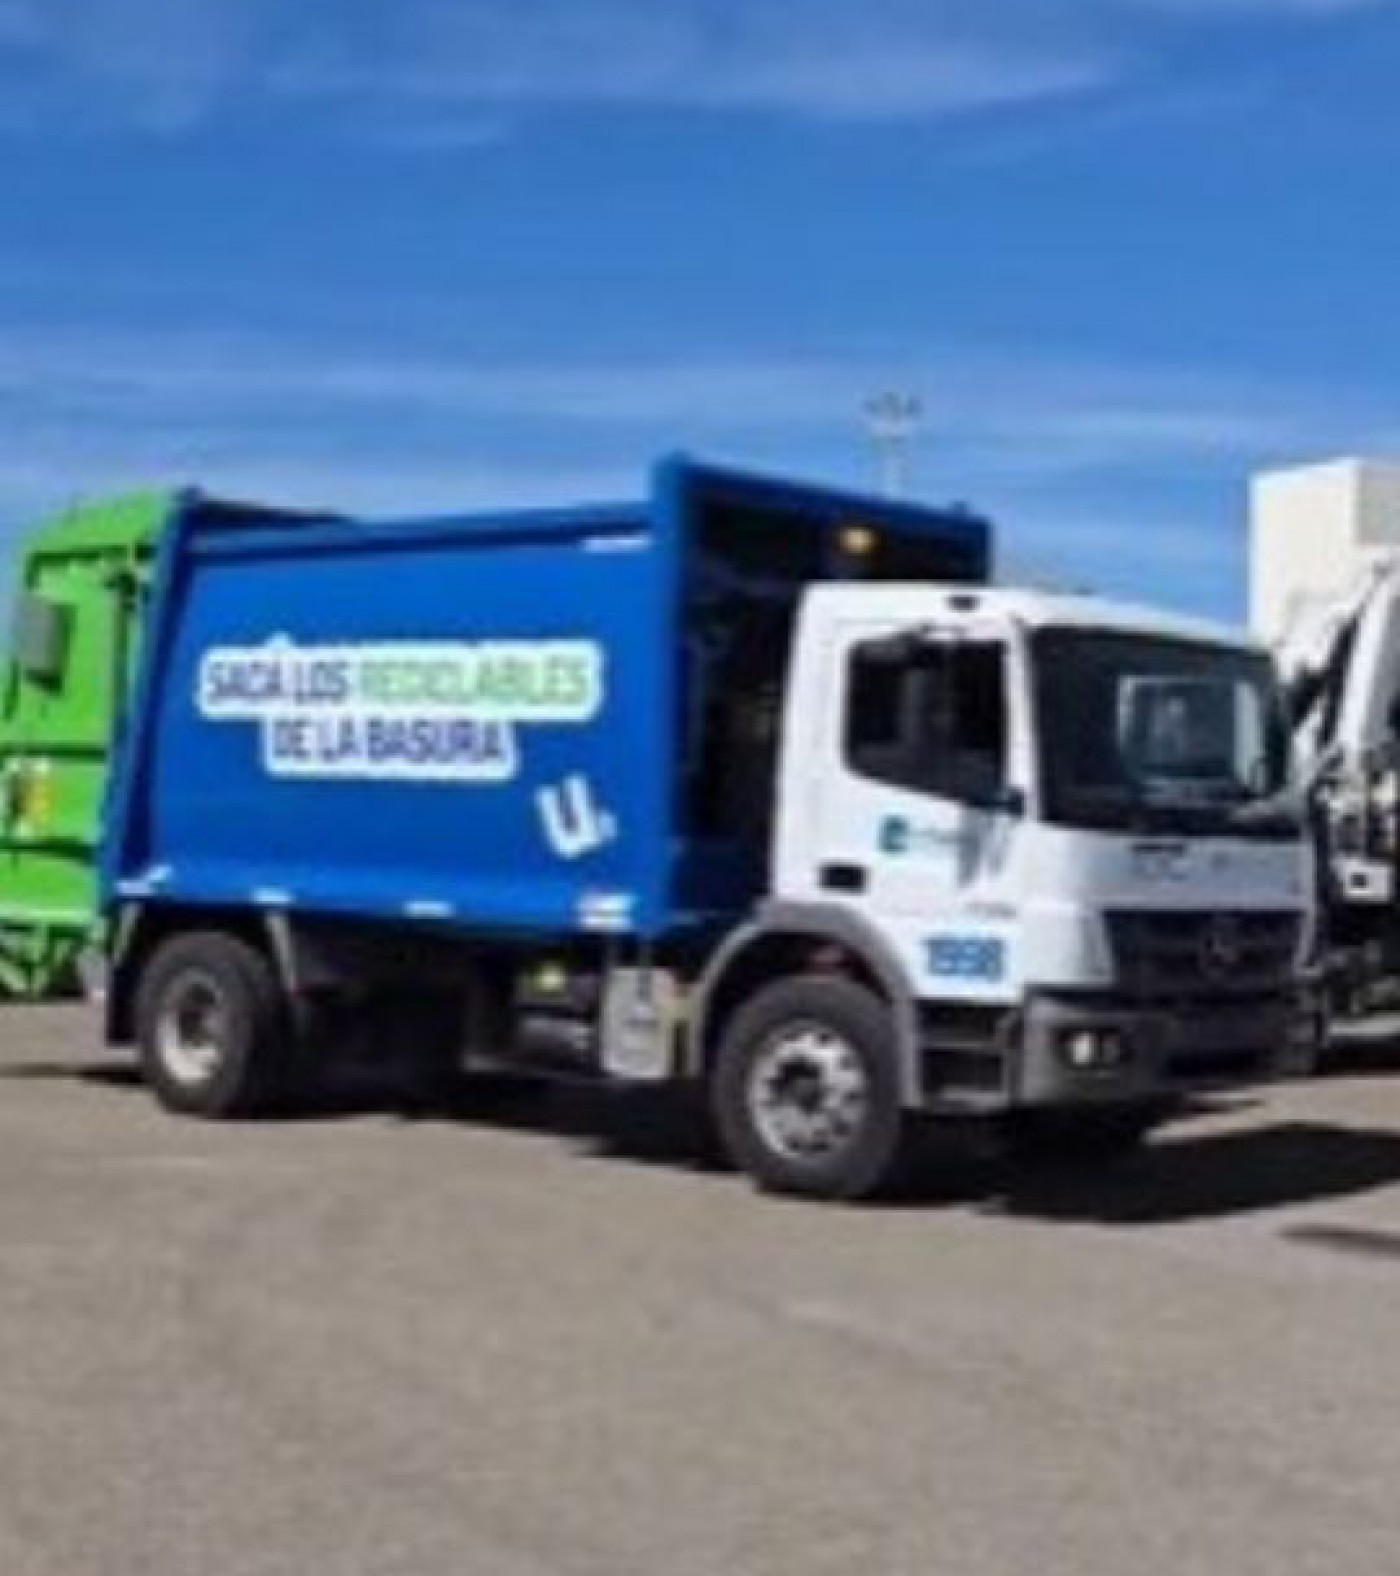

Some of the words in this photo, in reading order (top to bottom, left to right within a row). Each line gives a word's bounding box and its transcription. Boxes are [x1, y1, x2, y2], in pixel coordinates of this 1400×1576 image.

[294, 659, 350, 702] LOS
[360, 656, 590, 702] RECICLABLES
[272, 719, 315, 761] DE
[323, 720, 357, 762] LA
[366, 720, 503, 763] BASURA
